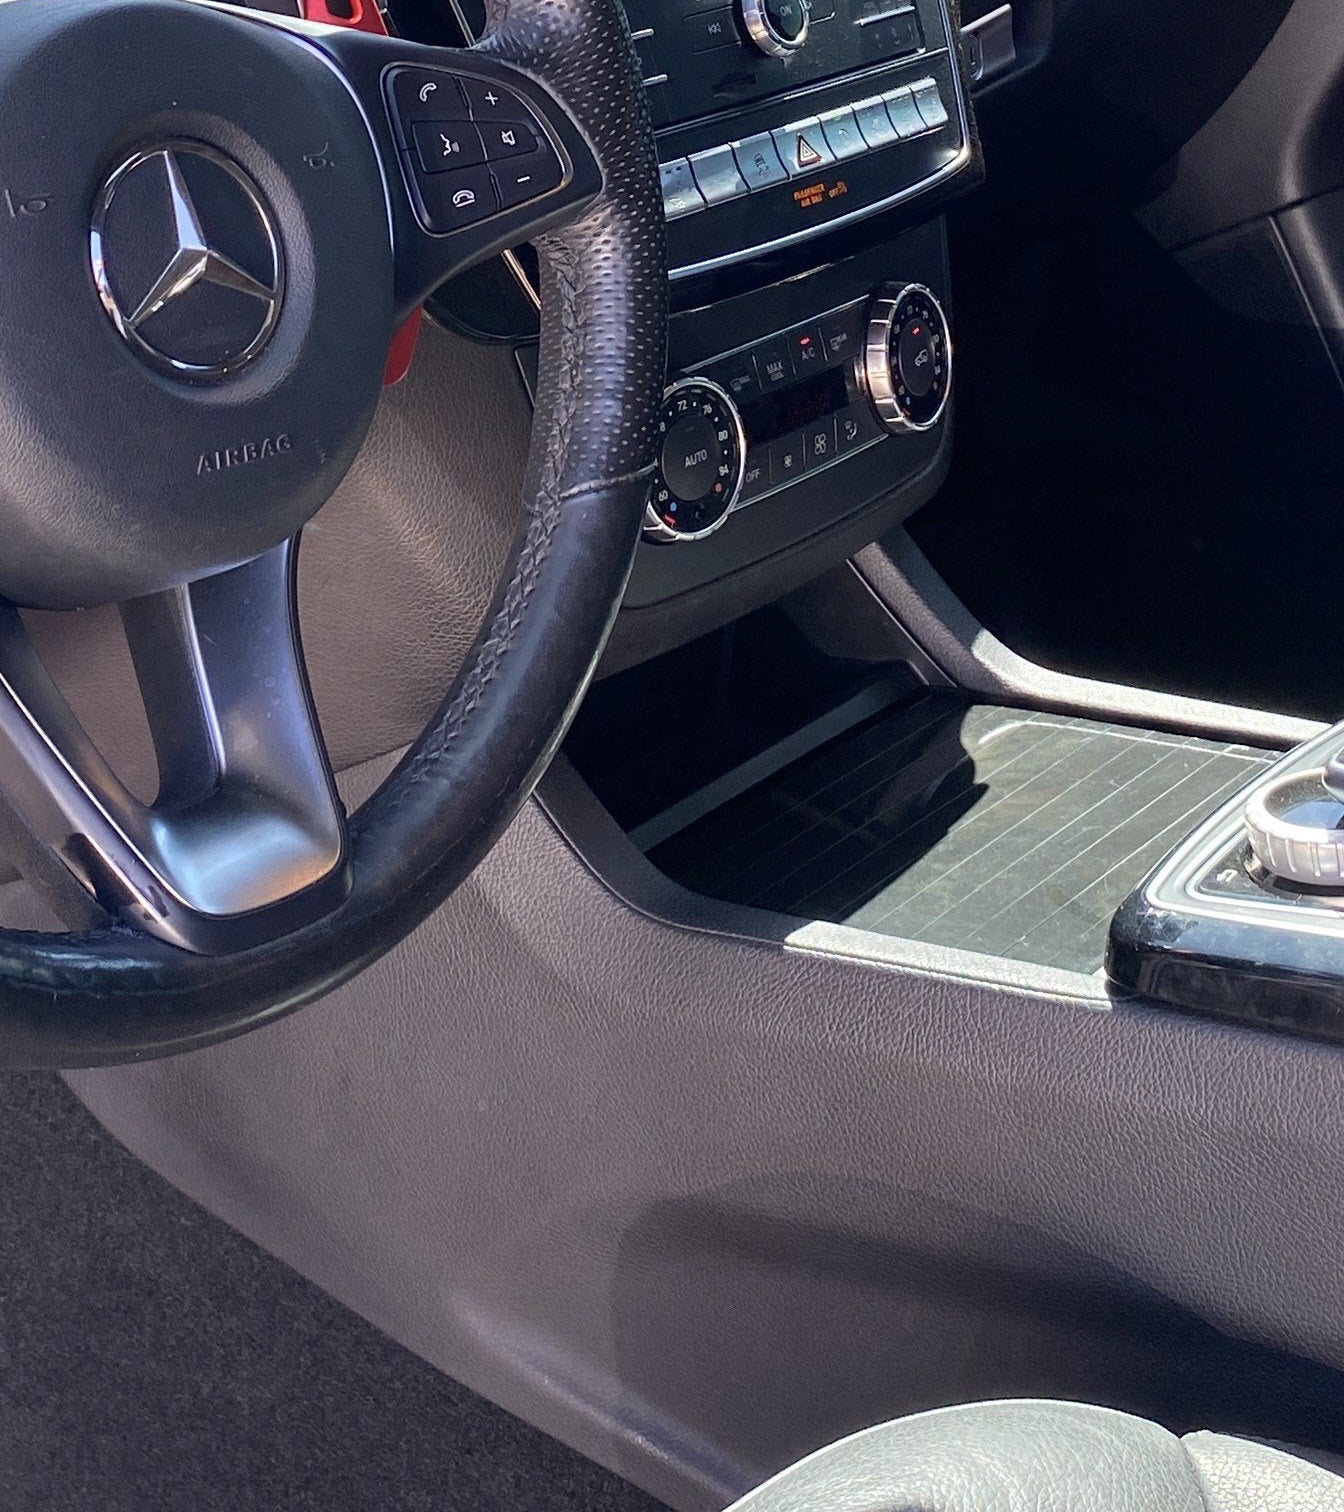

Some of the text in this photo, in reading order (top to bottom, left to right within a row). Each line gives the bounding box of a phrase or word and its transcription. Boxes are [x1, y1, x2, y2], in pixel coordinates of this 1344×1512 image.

[779, 6, 793, 17] ON
[766, 359, 784, 375] MAX
[677, 399, 688, 412] 72
[197, 433, 291, 476] AIRBAG
[684, 449, 707, 469] AUTO
[745, 468, 761, 483] OFF
